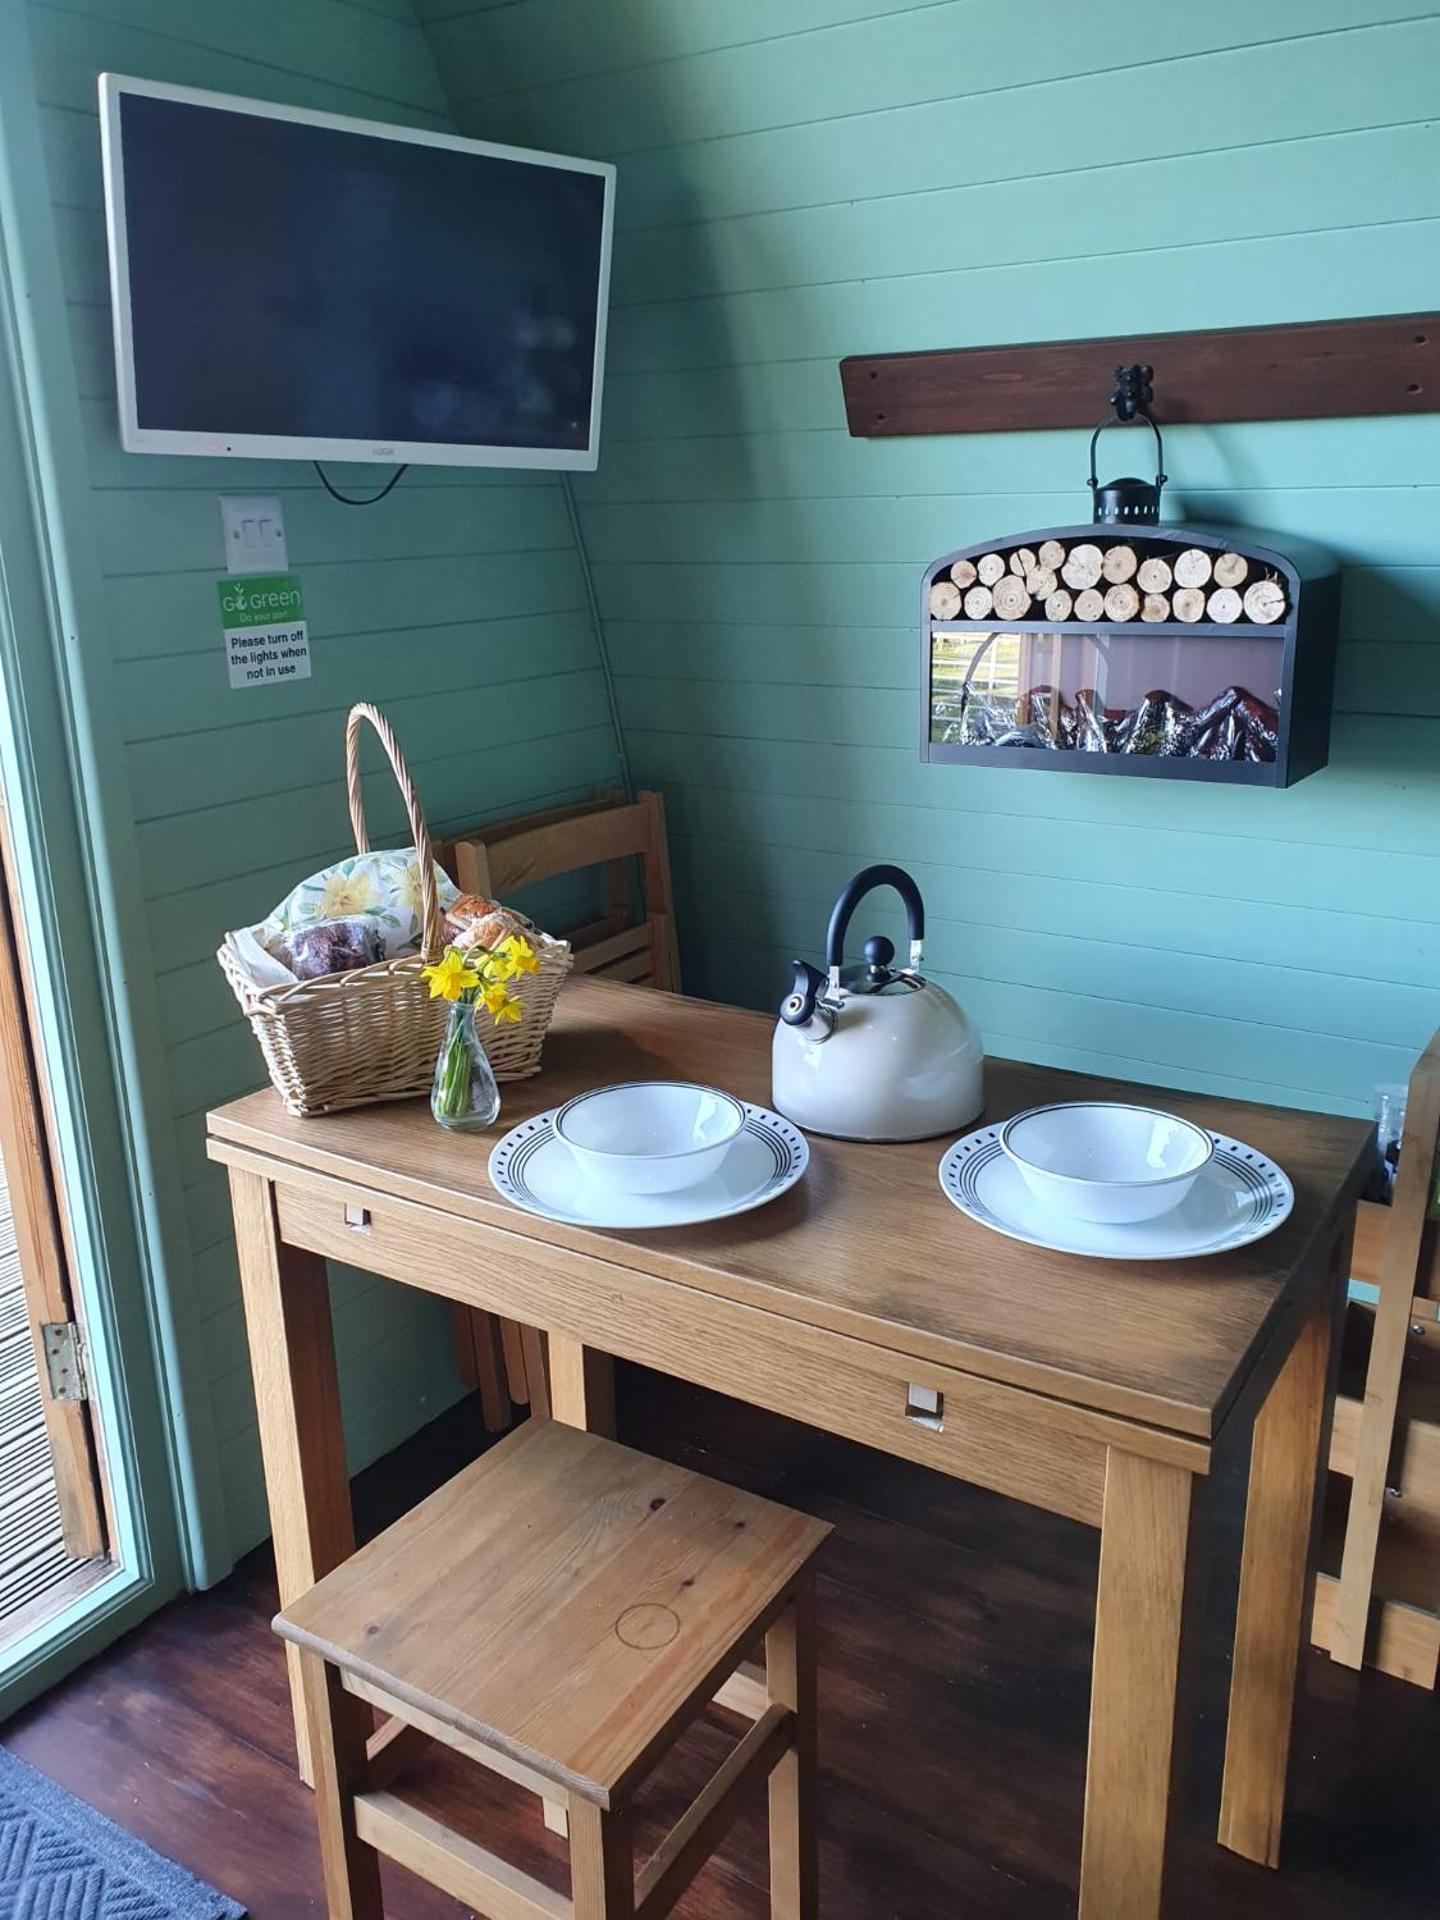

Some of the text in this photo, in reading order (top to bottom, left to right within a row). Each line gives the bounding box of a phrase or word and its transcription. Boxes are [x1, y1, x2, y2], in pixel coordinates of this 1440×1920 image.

[250, 590, 301, 609] Green
[231, 630, 304, 649] Please turn off
[231, 648, 307, 665] the lights when
[246, 664, 296, 679] not in use
